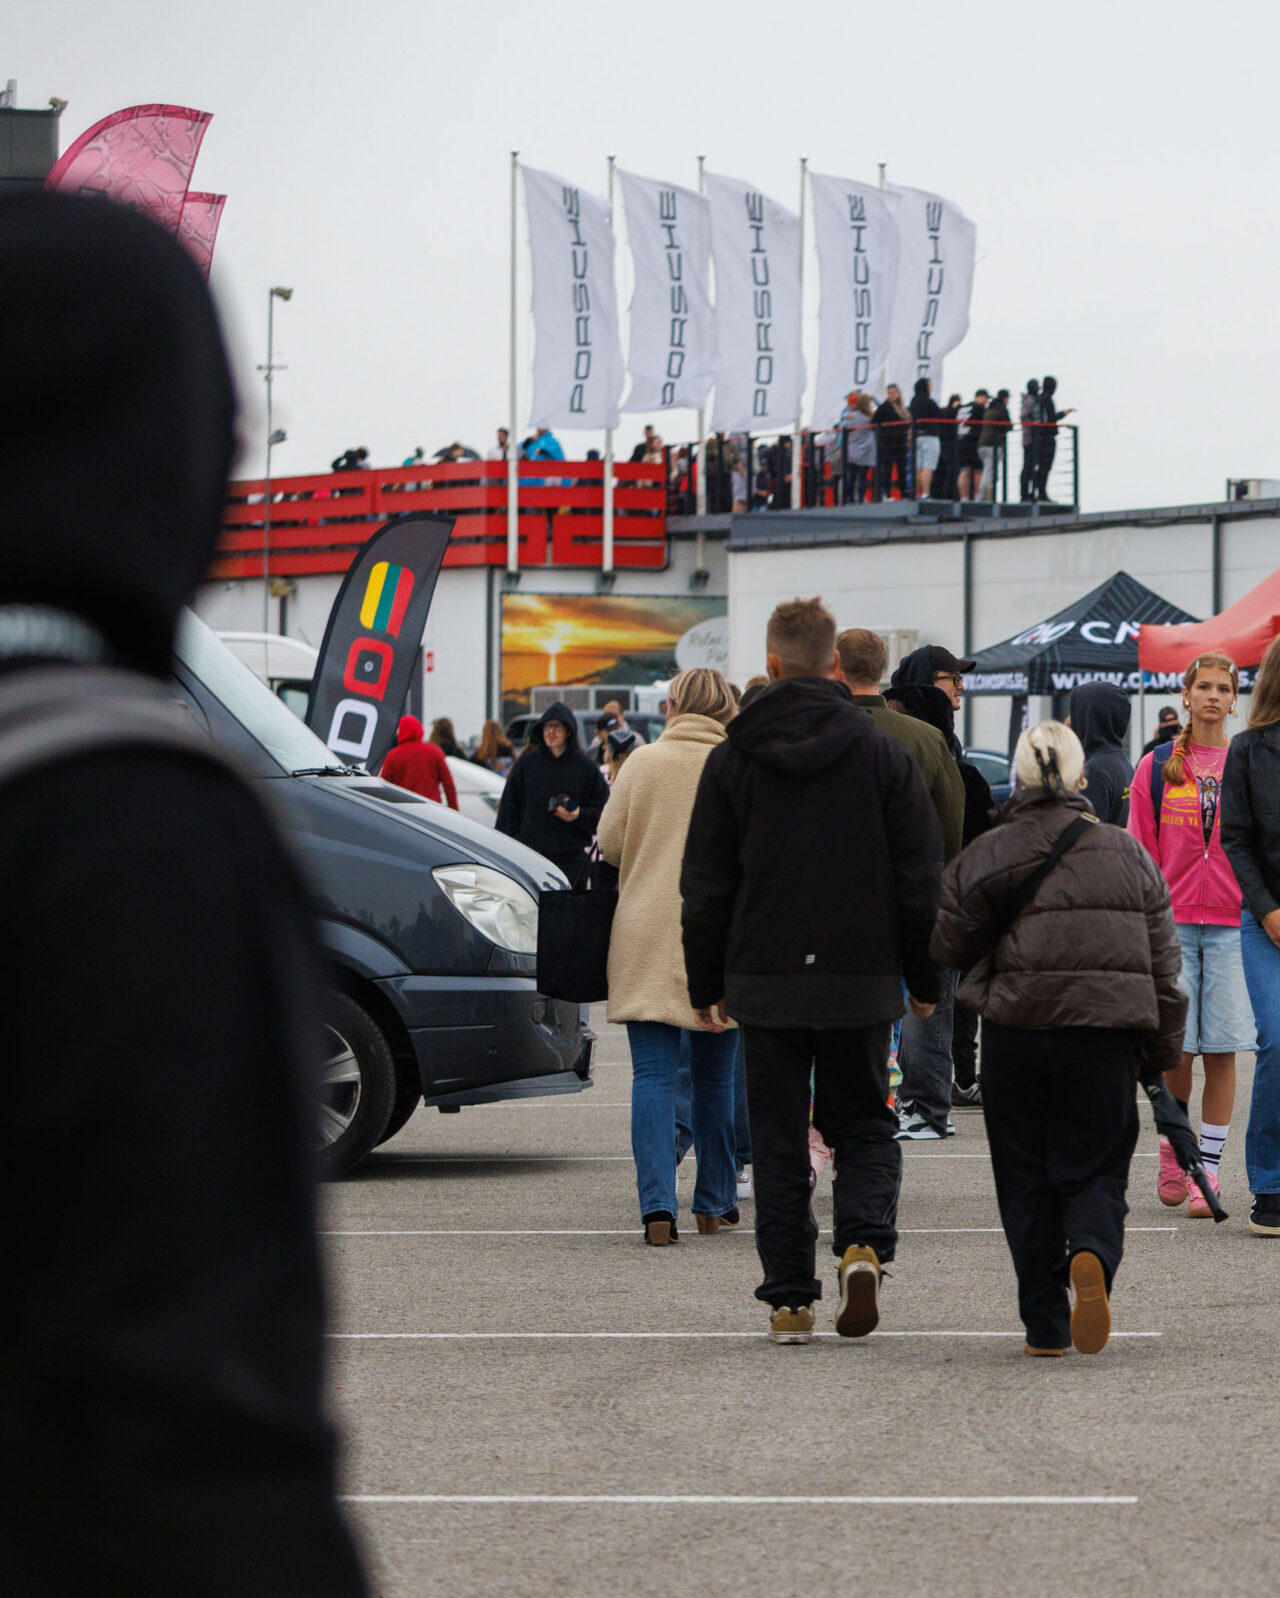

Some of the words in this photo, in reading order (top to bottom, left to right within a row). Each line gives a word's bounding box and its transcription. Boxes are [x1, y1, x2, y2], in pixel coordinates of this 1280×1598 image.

[562, 186, 592, 414] PORSCHE
[660, 190, 688, 405] PORSCHE
[745, 191, 774, 417] PORSCHE
[847, 194, 872, 386] ORSCHE
[916, 201, 944, 378] RSCHE
